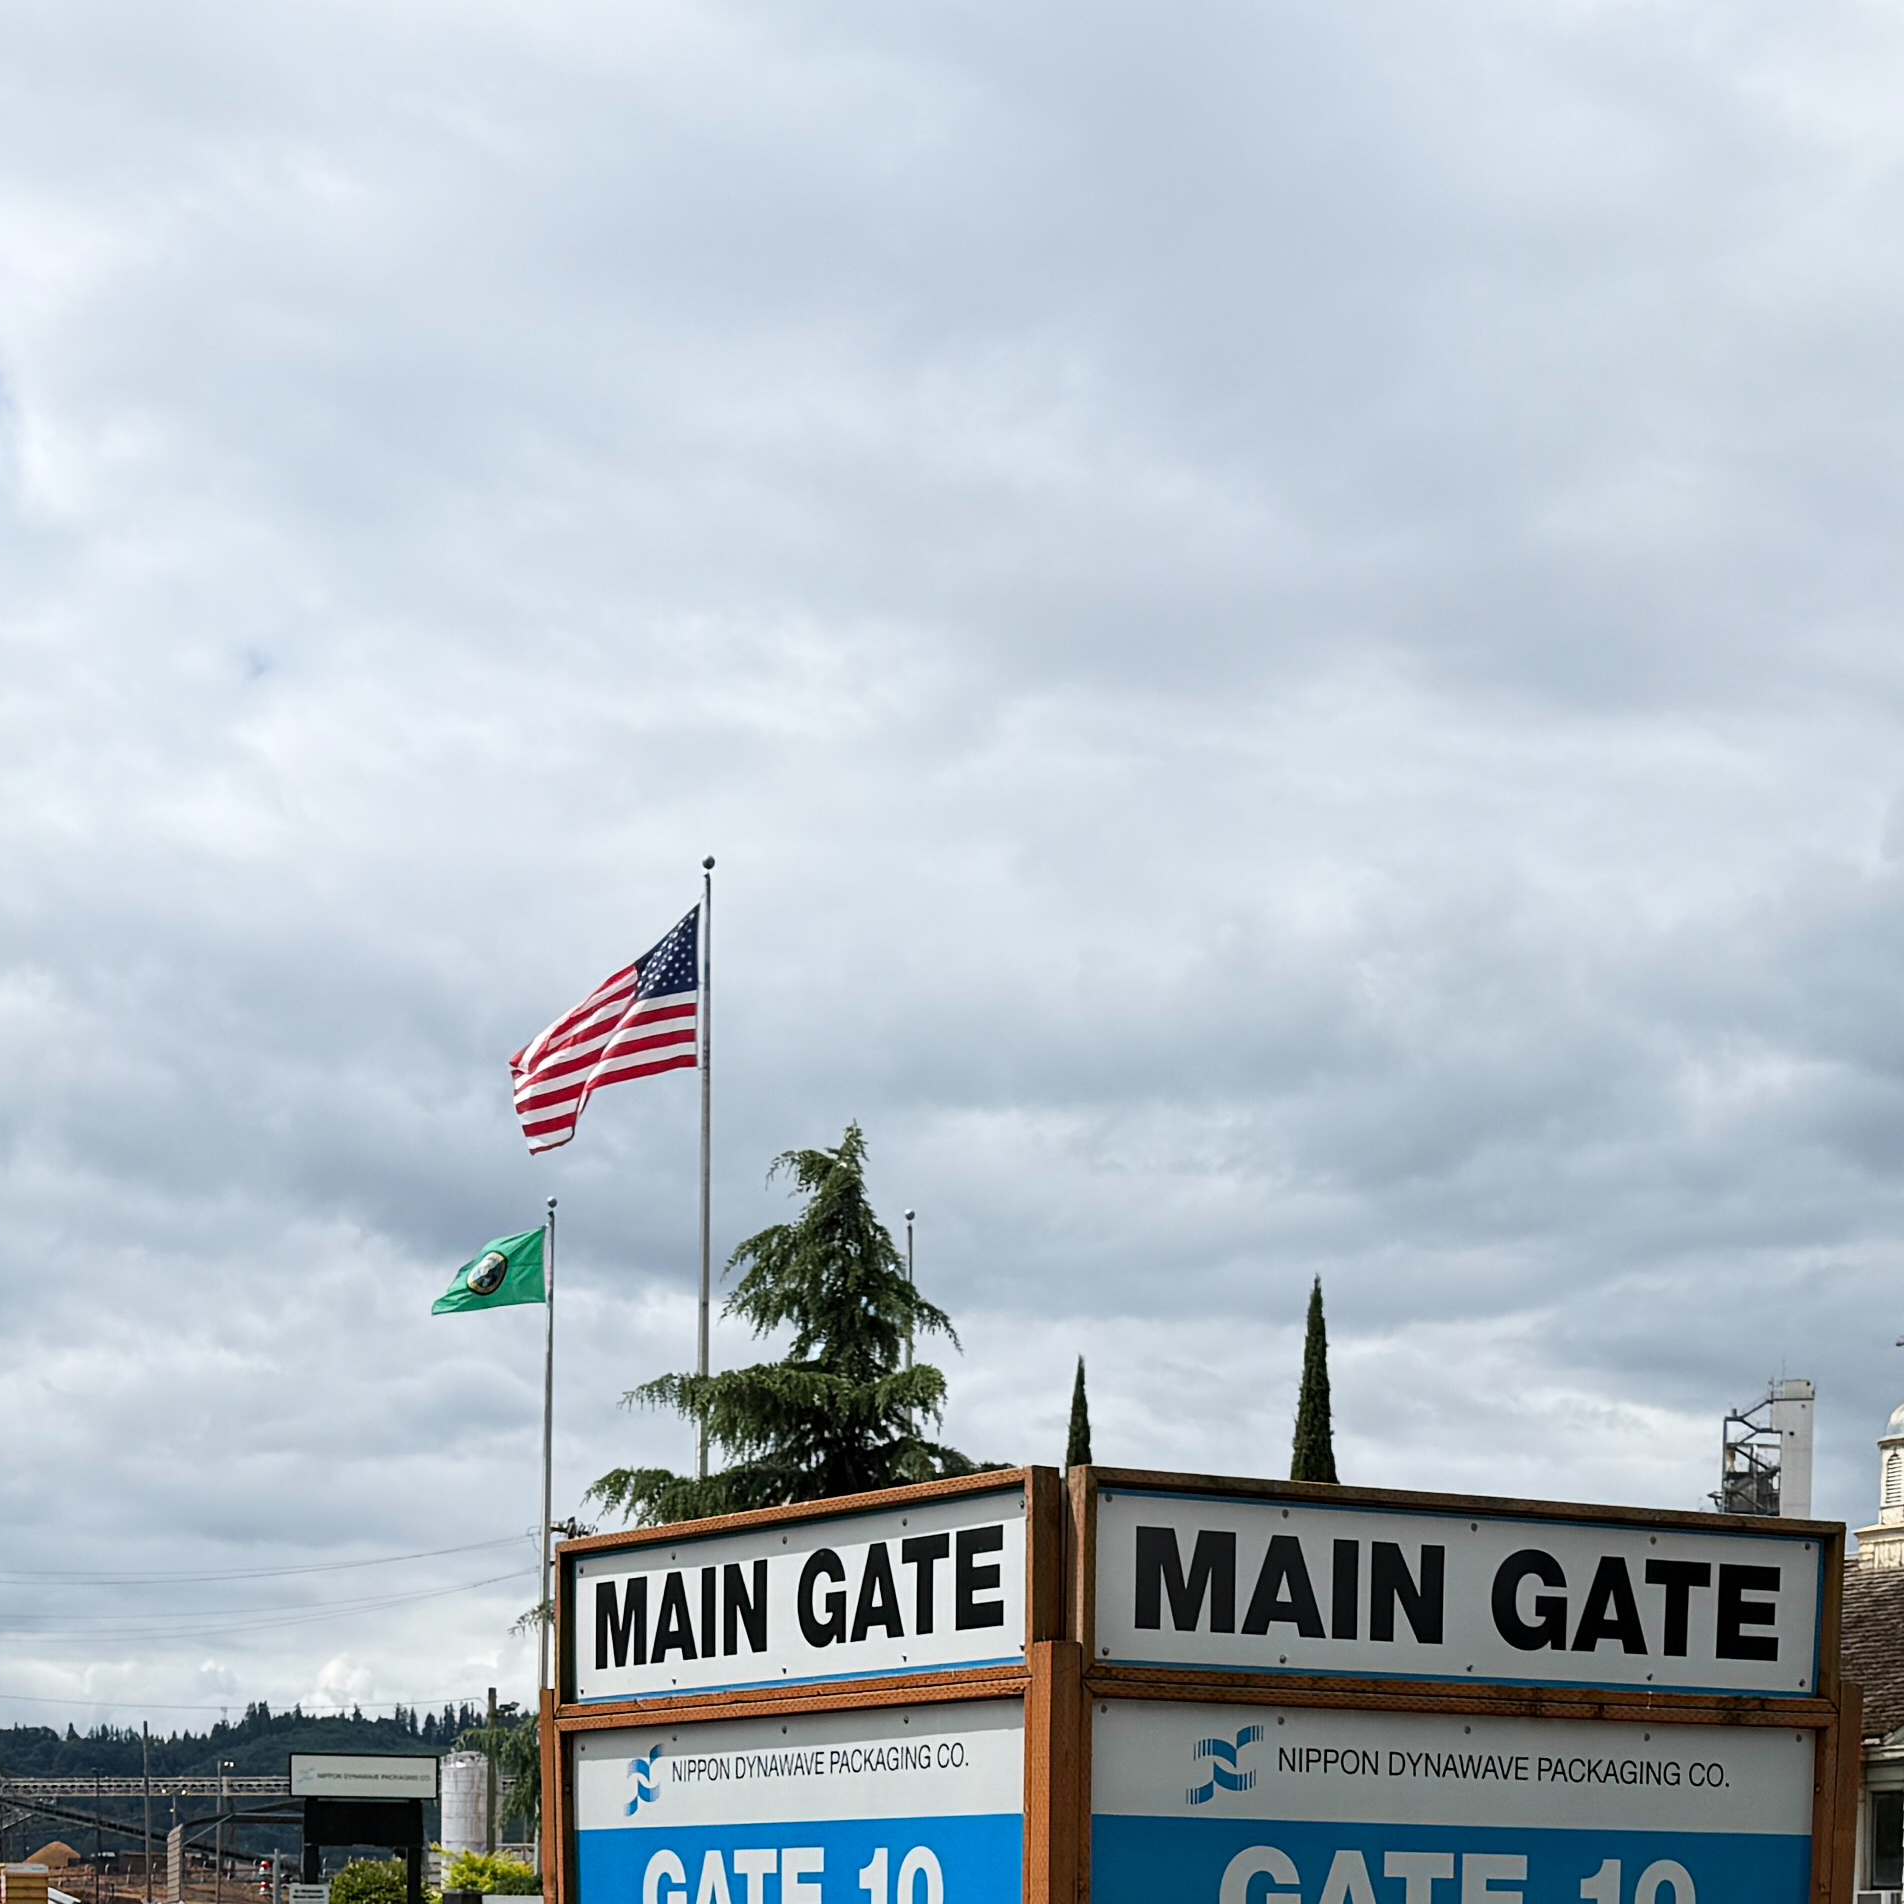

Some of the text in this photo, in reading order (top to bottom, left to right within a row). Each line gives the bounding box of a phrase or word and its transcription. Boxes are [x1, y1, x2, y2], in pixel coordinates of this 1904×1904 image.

[595, 1524, 1005, 1670] MAIN GATE
[1134, 1525, 1781, 1661] MAIN GATE
[673, 1742, 970, 1783] NIPPON DYNAWAVE PACKAGING CO.
[1277, 1746, 1730, 1789] NIPPON DYNAWAVE PACKAGING CO.
